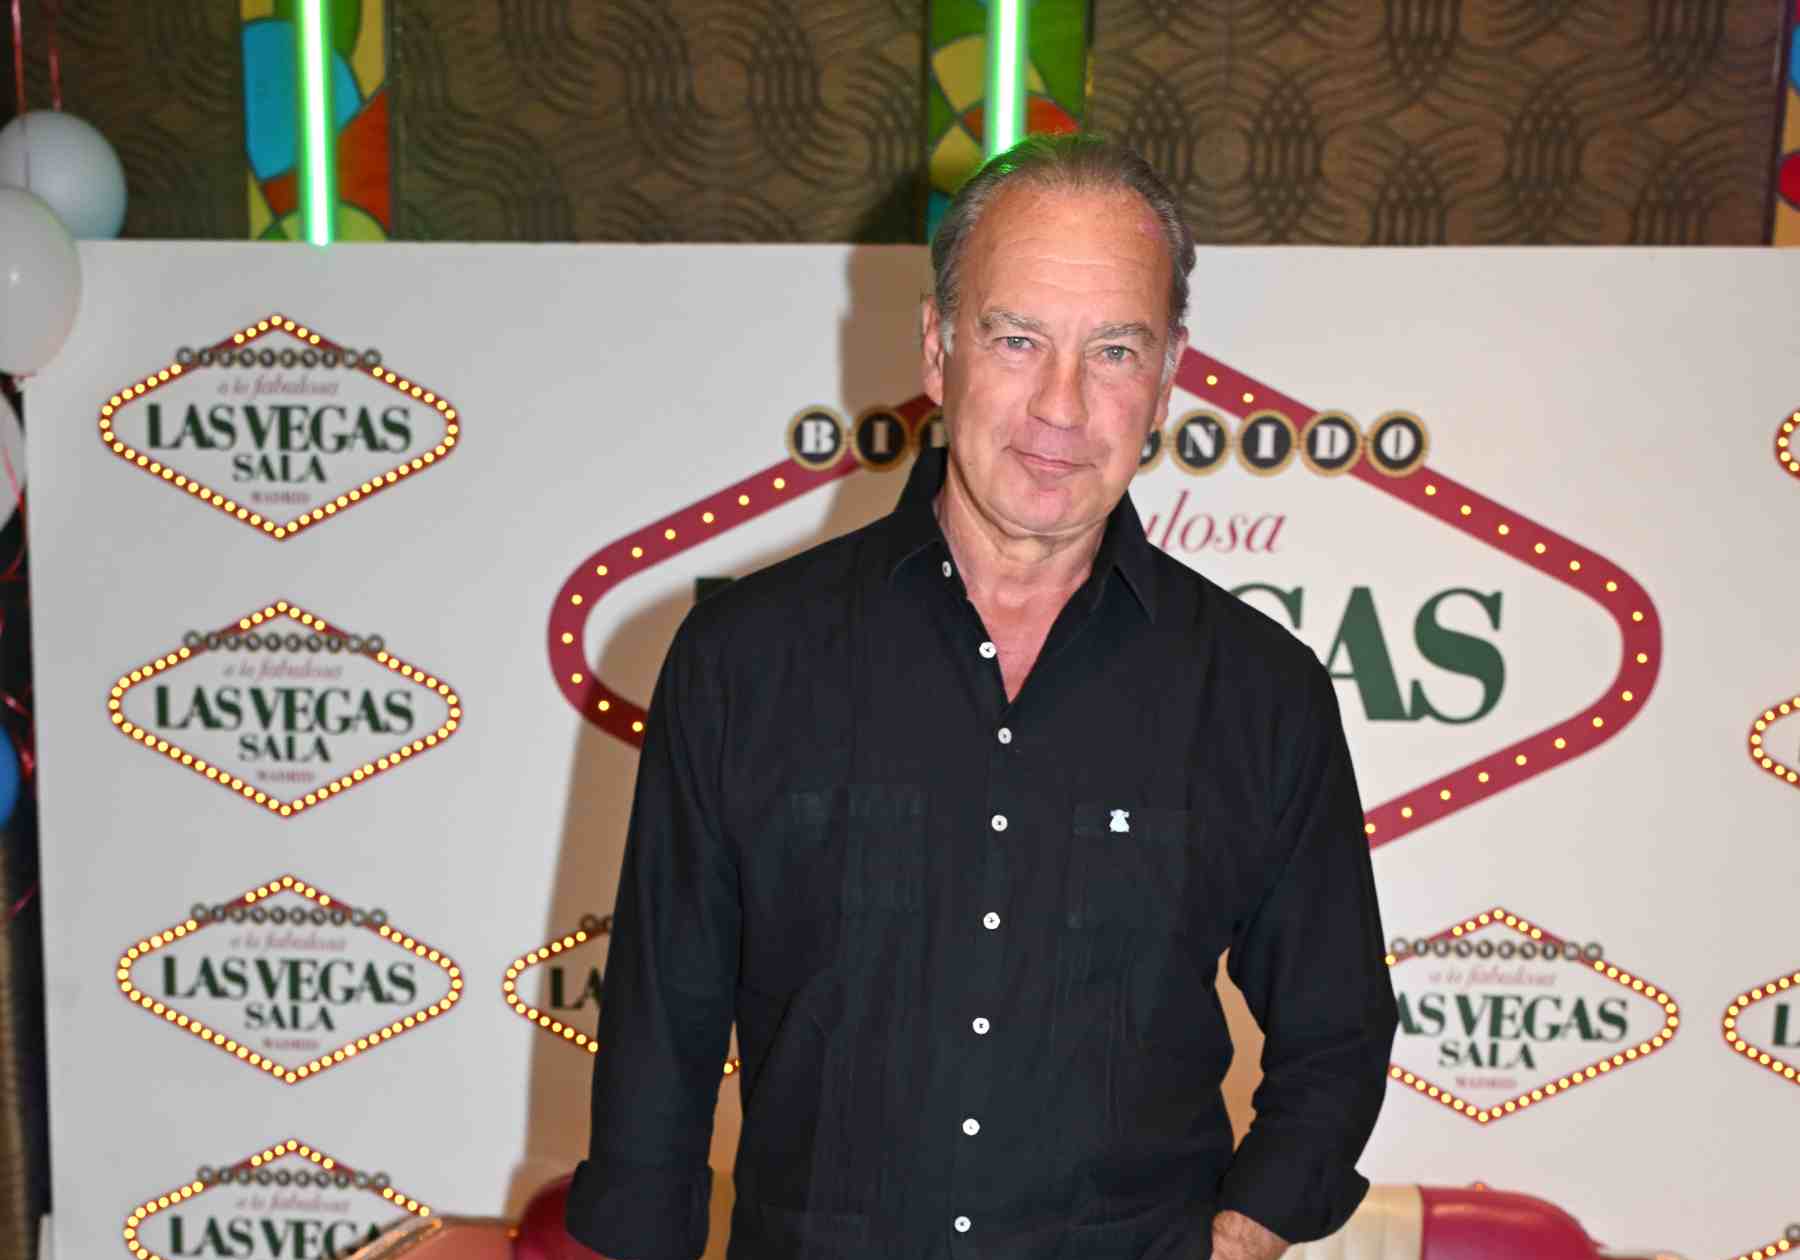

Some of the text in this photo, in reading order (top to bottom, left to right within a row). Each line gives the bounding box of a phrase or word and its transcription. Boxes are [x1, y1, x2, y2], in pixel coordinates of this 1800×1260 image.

[147, 403, 411, 453] LAS VEGAS
[233, 454, 327, 483] SALA
[155, 685, 414, 735] LAS VEGAS
[238, 734, 331, 763] SALA
[163, 955, 417, 1006] LAS VEGAS
[551, 967, 604, 1010] LA
[244, 1003, 335, 1031] SALA
[1398, 993, 1628, 1042] AS VEGAS
[1440, 1041, 1535, 1069] SALA
[169, 1216, 381, 1260] LAS VEG
